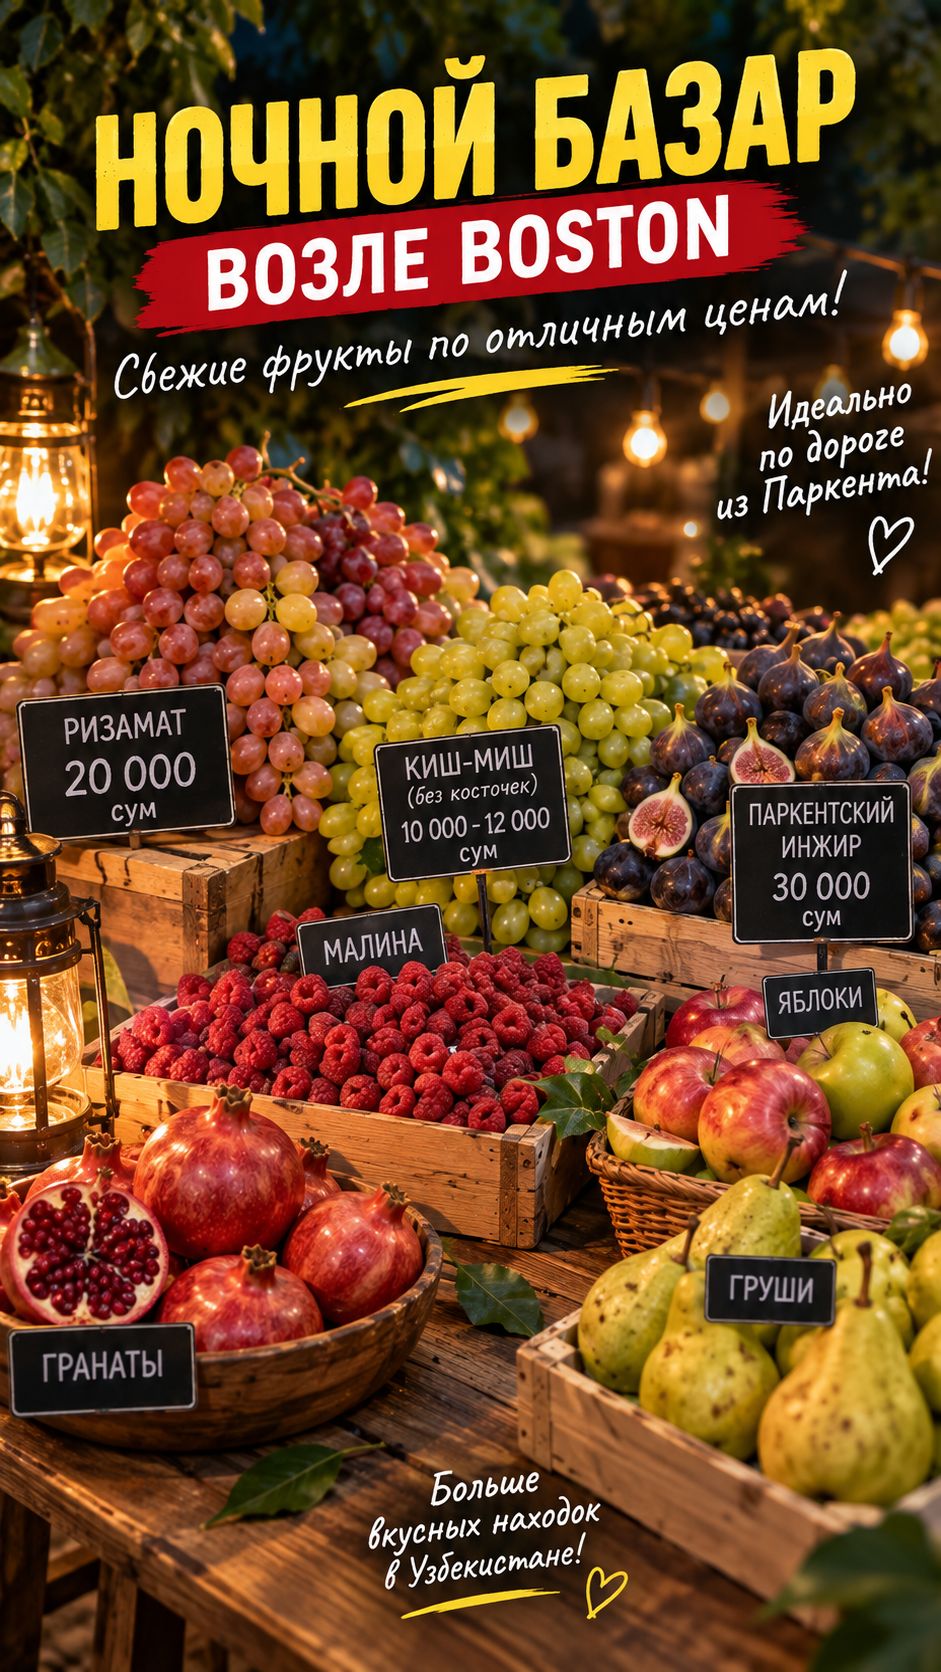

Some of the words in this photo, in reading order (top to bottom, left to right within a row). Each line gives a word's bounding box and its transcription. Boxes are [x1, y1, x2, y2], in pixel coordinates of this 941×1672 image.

[63, 708, 187, 745] РИЗАМАТ
[65, 757, 112, 798] 20
[123, 751, 197, 792] 000
[404, 743, 534, 781] КИШ-МИШ
[407, 785, 443, 810] (без
[450, 772, 538, 801] косточек)
[111, 801, 157, 827] сум
[401, 819, 424, 842] 10
[428, 815, 468, 841] 000
[484, 811, 506, 835] 12
[511, 806, 550, 832] 000
[749, 795, 894, 826] ПАРКЕНТСКИЙ
[459, 844, 498, 867] сум
[782, 834, 862, 859] ИНЖИР
[772, 872, 807, 902] 30
[816, 871, 871, 901] 000
[802, 909, 841, 931] сум
[323, 927, 424, 966] МАЛИНА
[778, 985, 863, 1015] ЯБЛОКИ
[729, 1274, 814, 1303] ГРУШИ
[42, 1349, 163, 1382] ГРАНАТЫ
